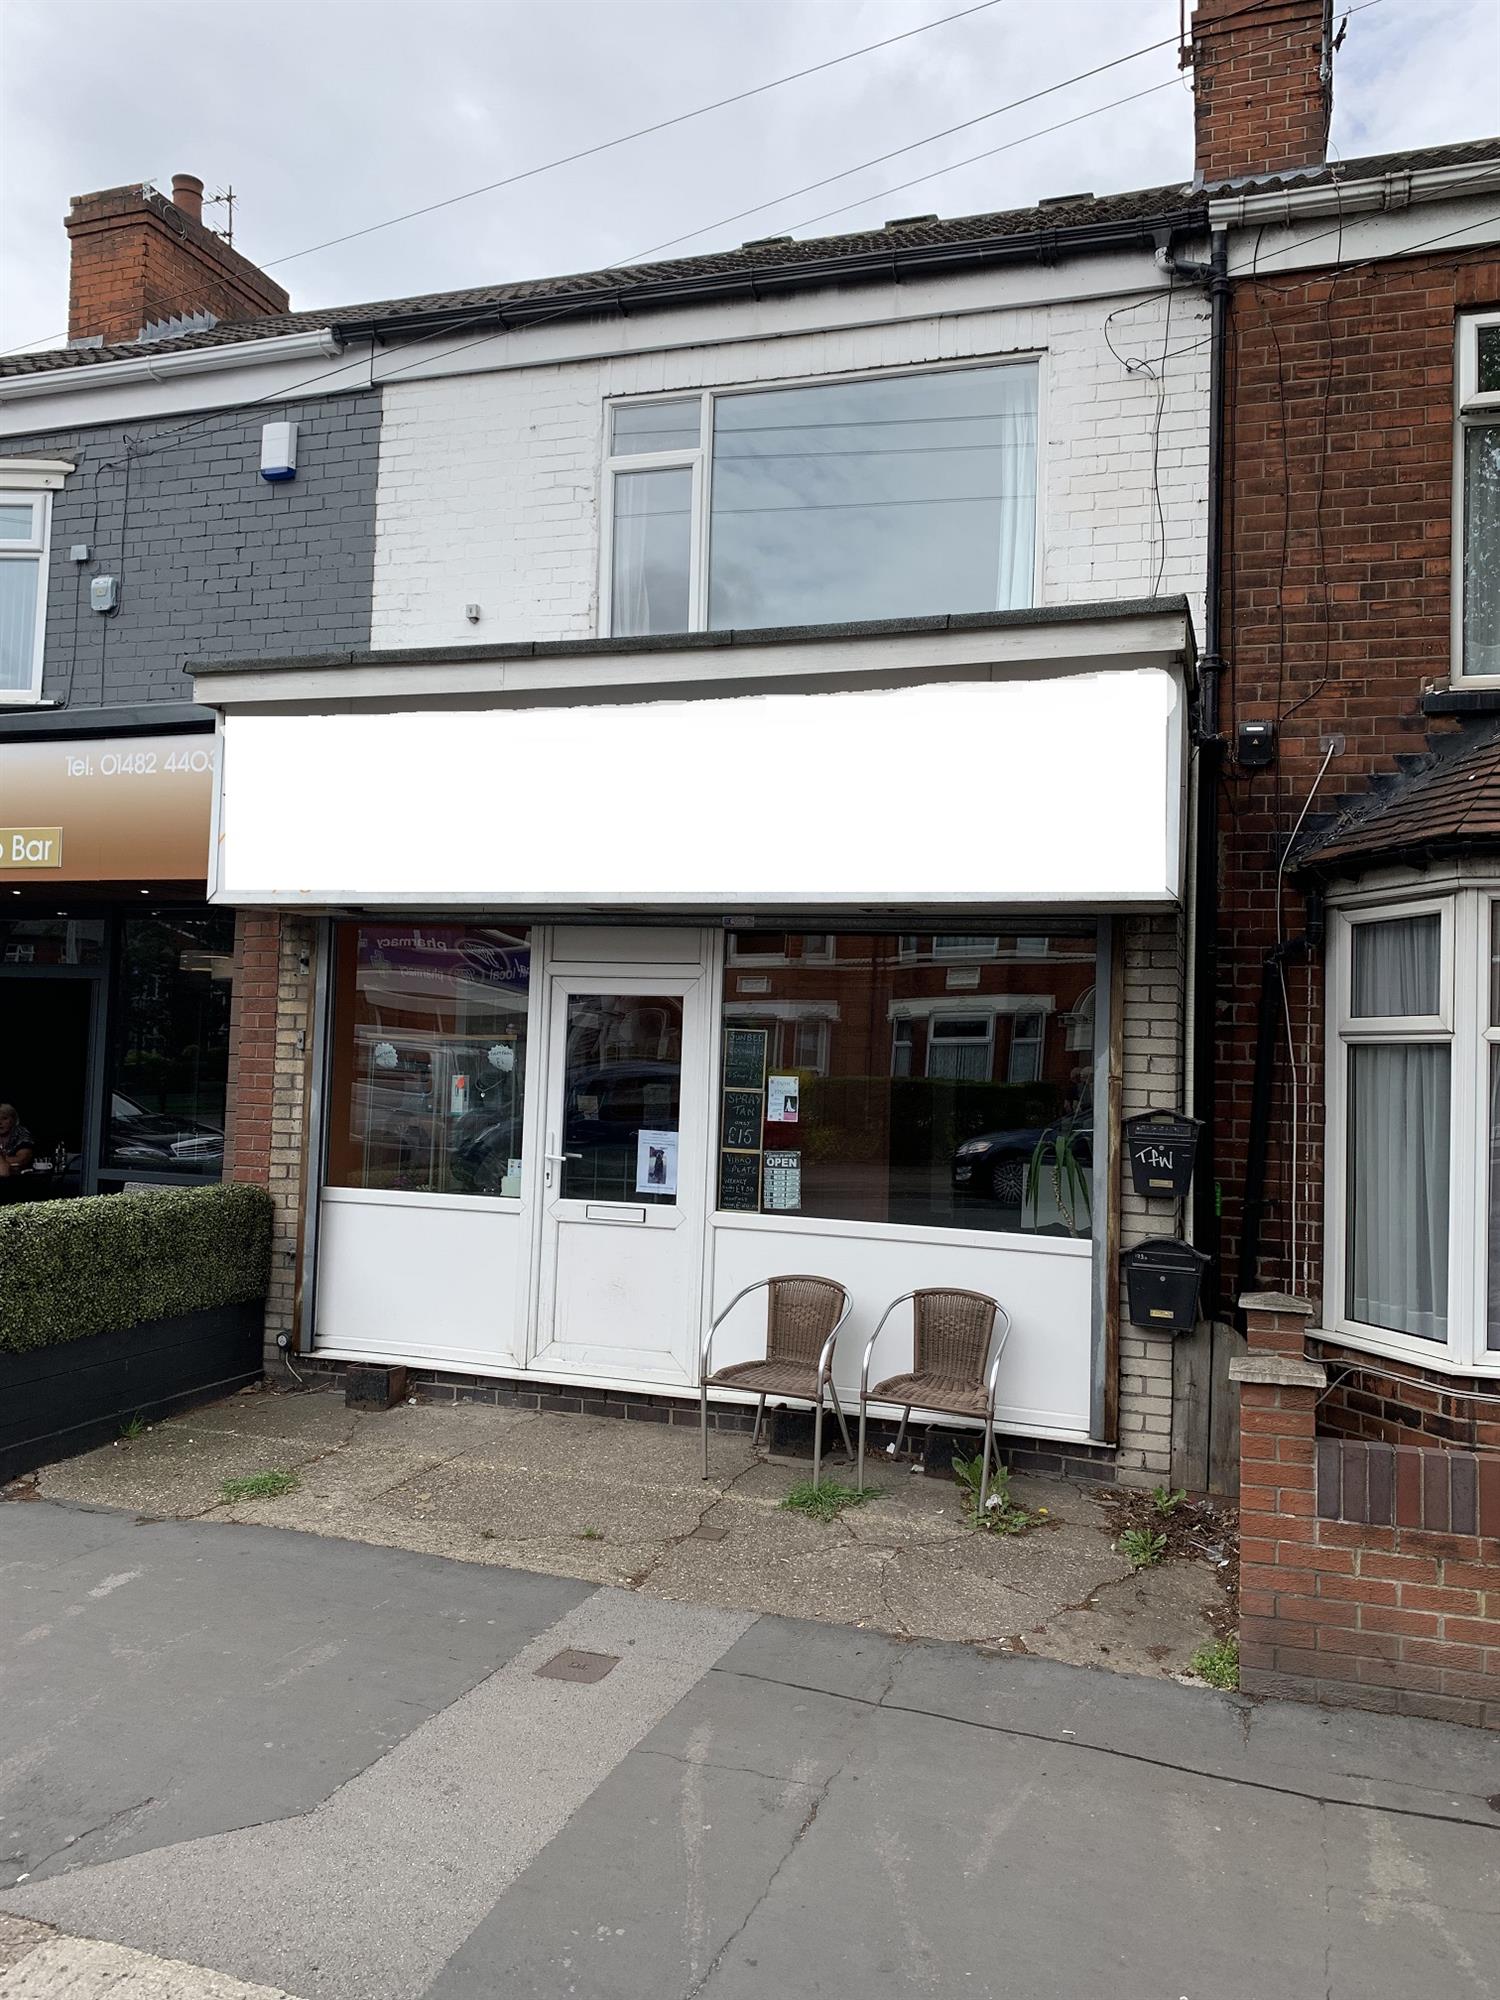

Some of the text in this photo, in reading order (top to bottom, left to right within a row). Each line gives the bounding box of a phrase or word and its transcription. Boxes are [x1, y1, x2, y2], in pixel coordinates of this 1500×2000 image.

[100, 752, 157, 776] 01482
[12, 835, 53, 862] Bar
[727, 1094, 761, 1105] SPRAY
[733, 1105, 755, 1116] TAN
[728, 1127, 754, 1145] £15
[766, 1157, 797, 1167] OPEN
